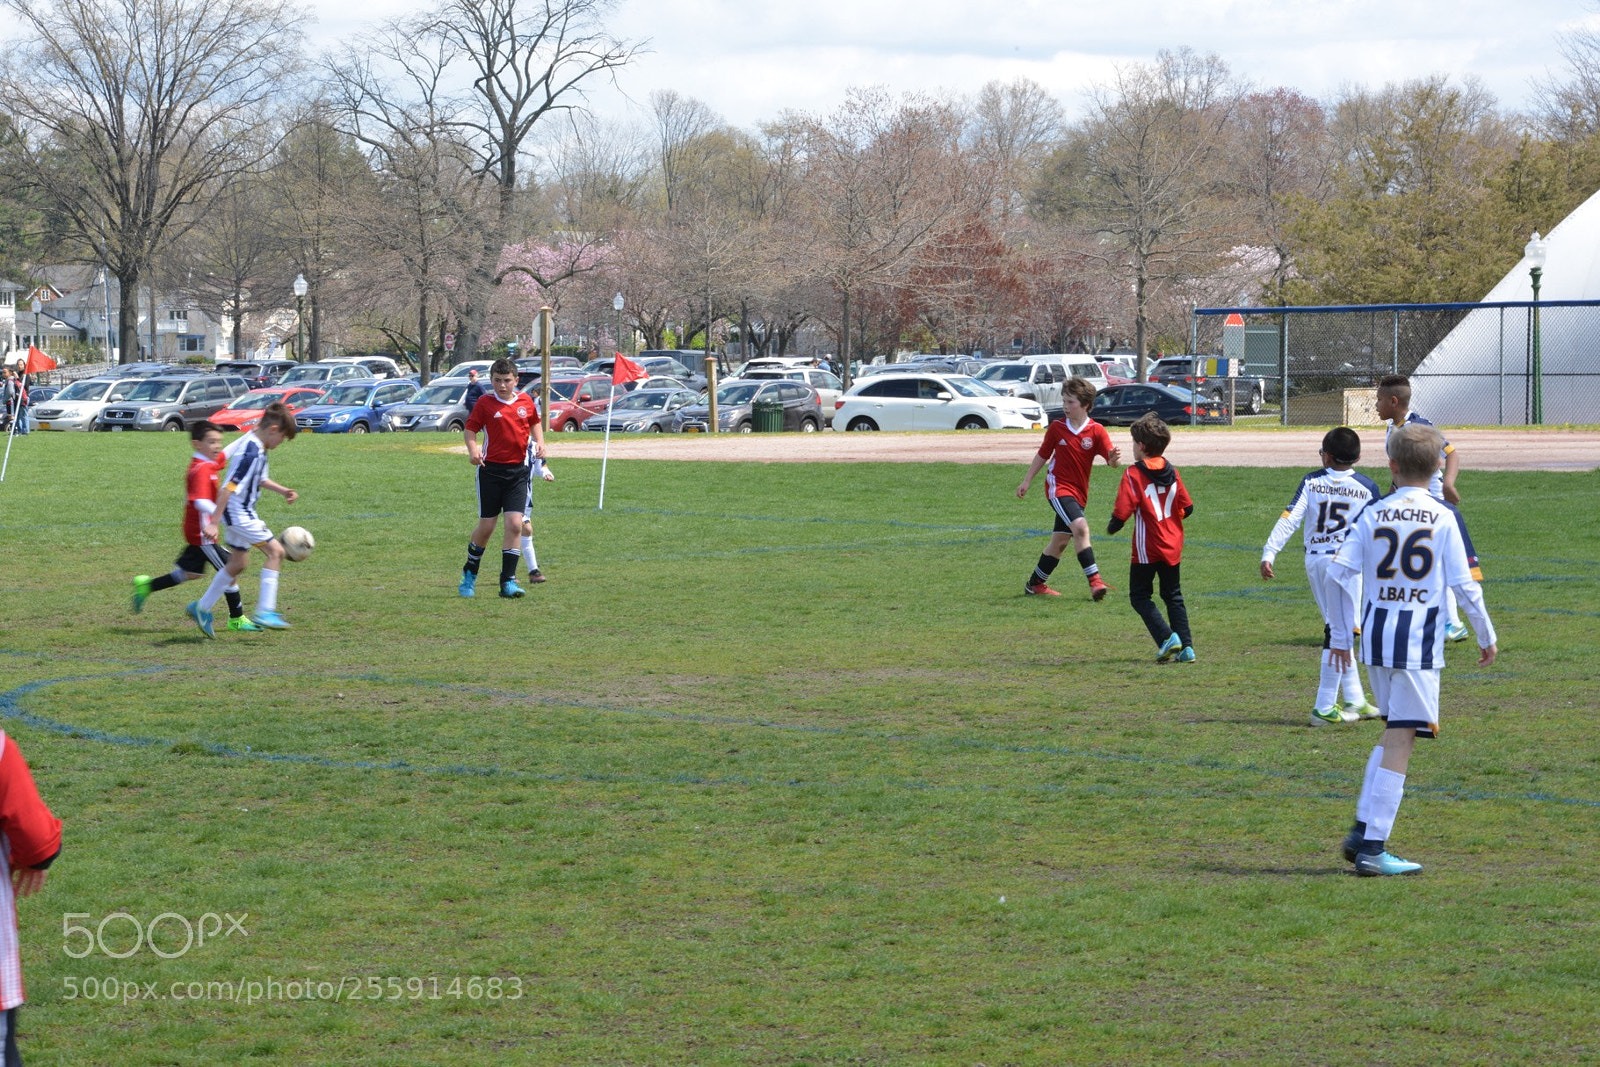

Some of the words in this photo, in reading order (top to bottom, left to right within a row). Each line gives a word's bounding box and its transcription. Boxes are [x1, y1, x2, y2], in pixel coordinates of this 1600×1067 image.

[1144, 481, 1178, 522] 17
[1316, 500, 1350, 535] 15
[1376, 508, 1439, 525] TKACHEV
[1373, 526, 1434, 582] 26
[1377, 586, 1406, 603] LBA
[1408, 587, 1429, 605] FC
